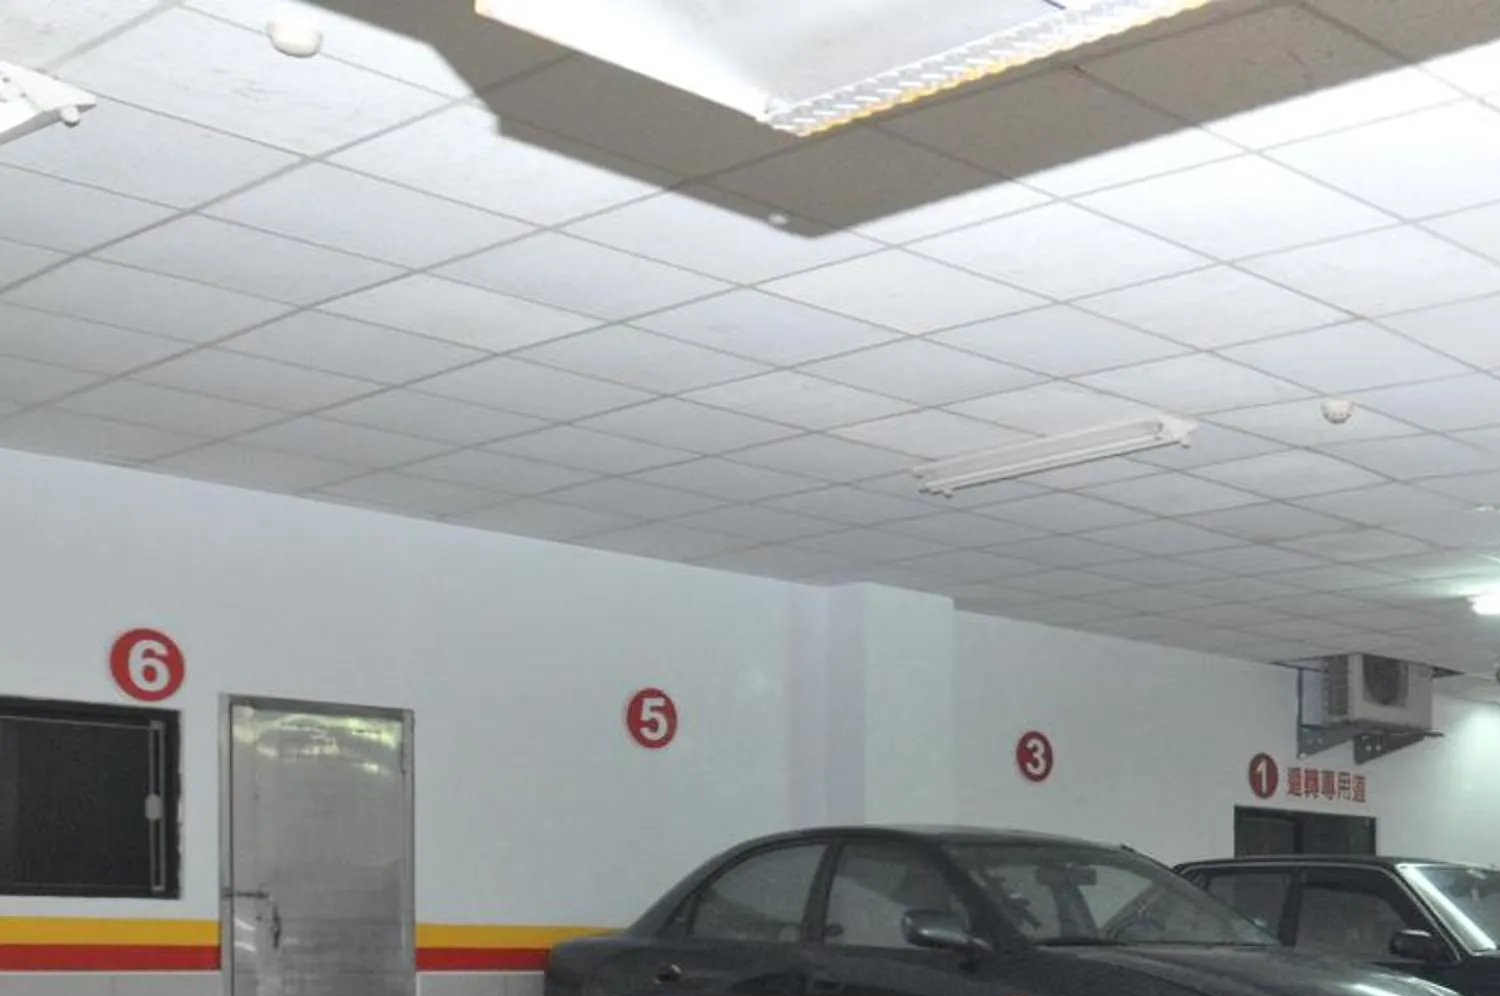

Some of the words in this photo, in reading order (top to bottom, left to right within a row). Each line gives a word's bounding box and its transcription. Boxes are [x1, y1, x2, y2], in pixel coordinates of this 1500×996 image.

[127, 640, 169, 692] 6
[640, 696, 669, 740] 5
[1026, 738, 1048, 775] 3
